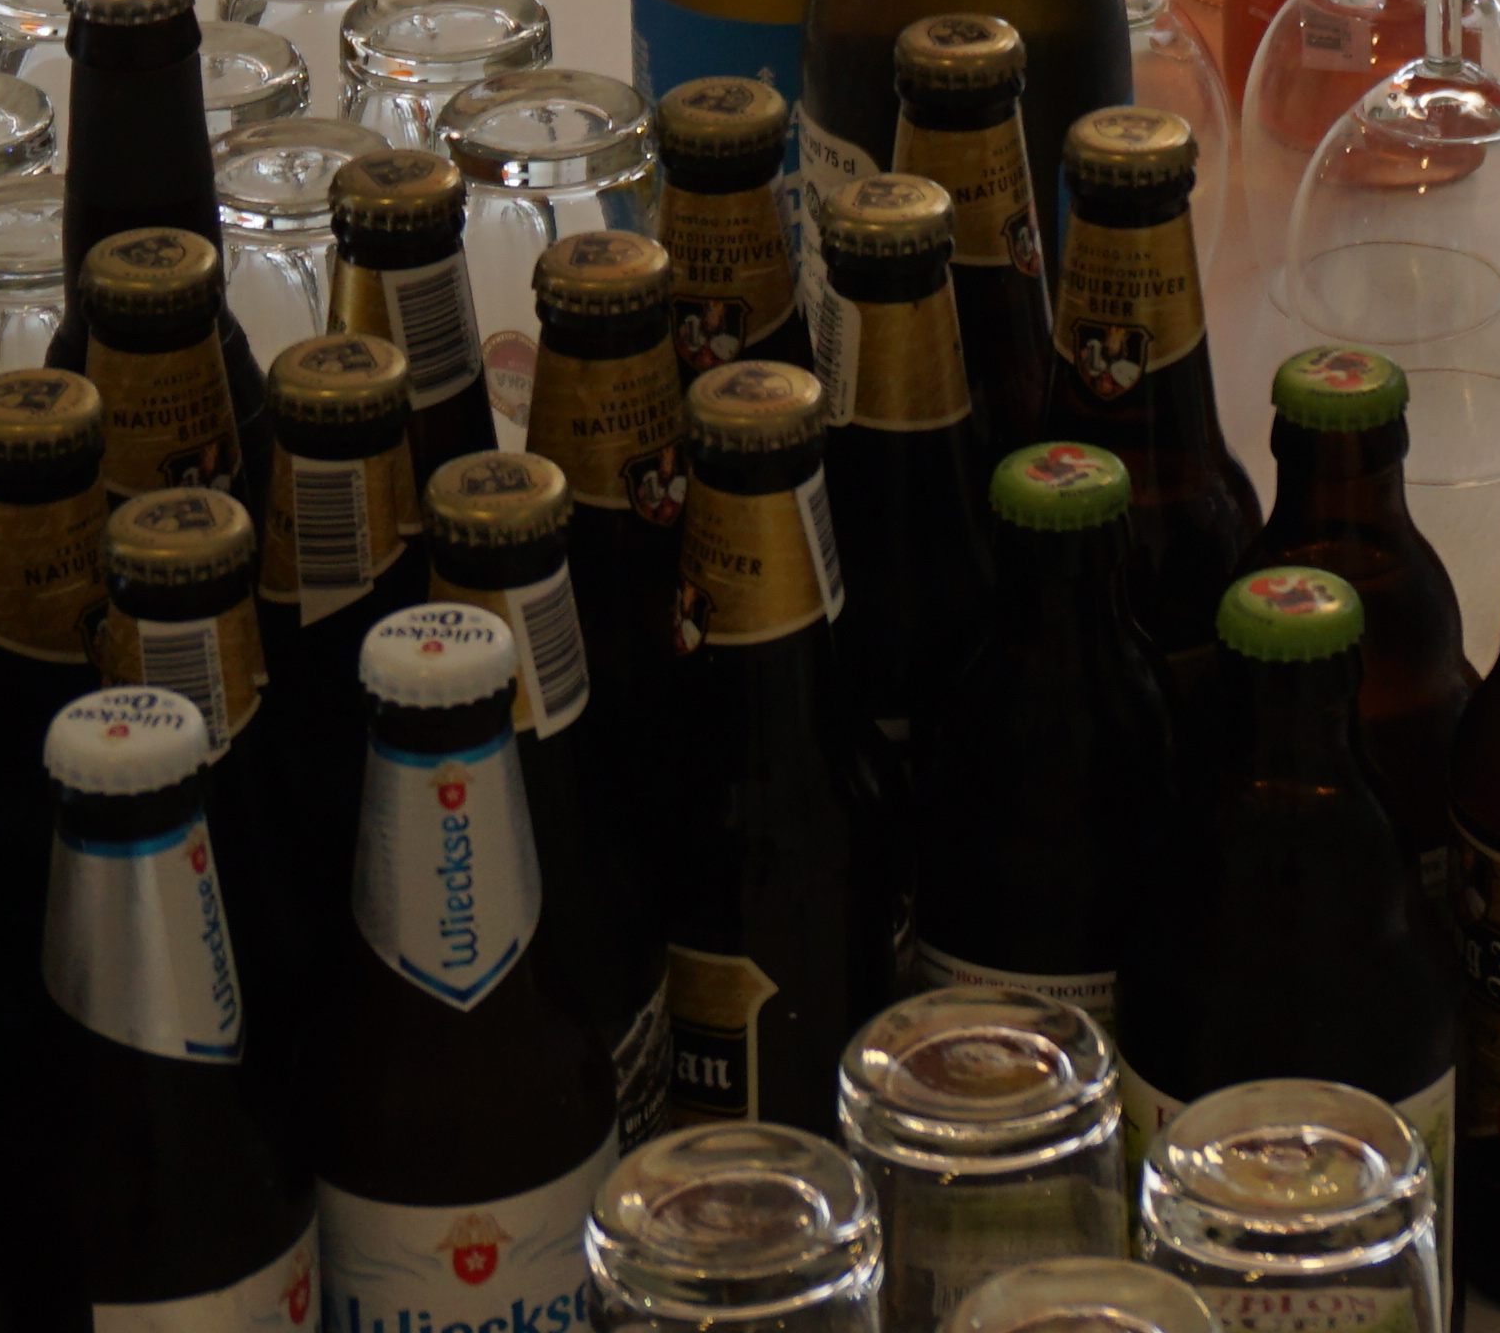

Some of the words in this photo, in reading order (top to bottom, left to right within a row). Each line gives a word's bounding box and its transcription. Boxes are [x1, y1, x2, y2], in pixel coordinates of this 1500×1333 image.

[823, 144, 841, 170] 75
[688, 265, 734, 284] BIER
[1089, 295, 1134, 317] BIER
[437, 811, 479, 971] Wieckse
[198, 873, 238, 1032] Wieckse
[676, 1050, 733, 1091] an
